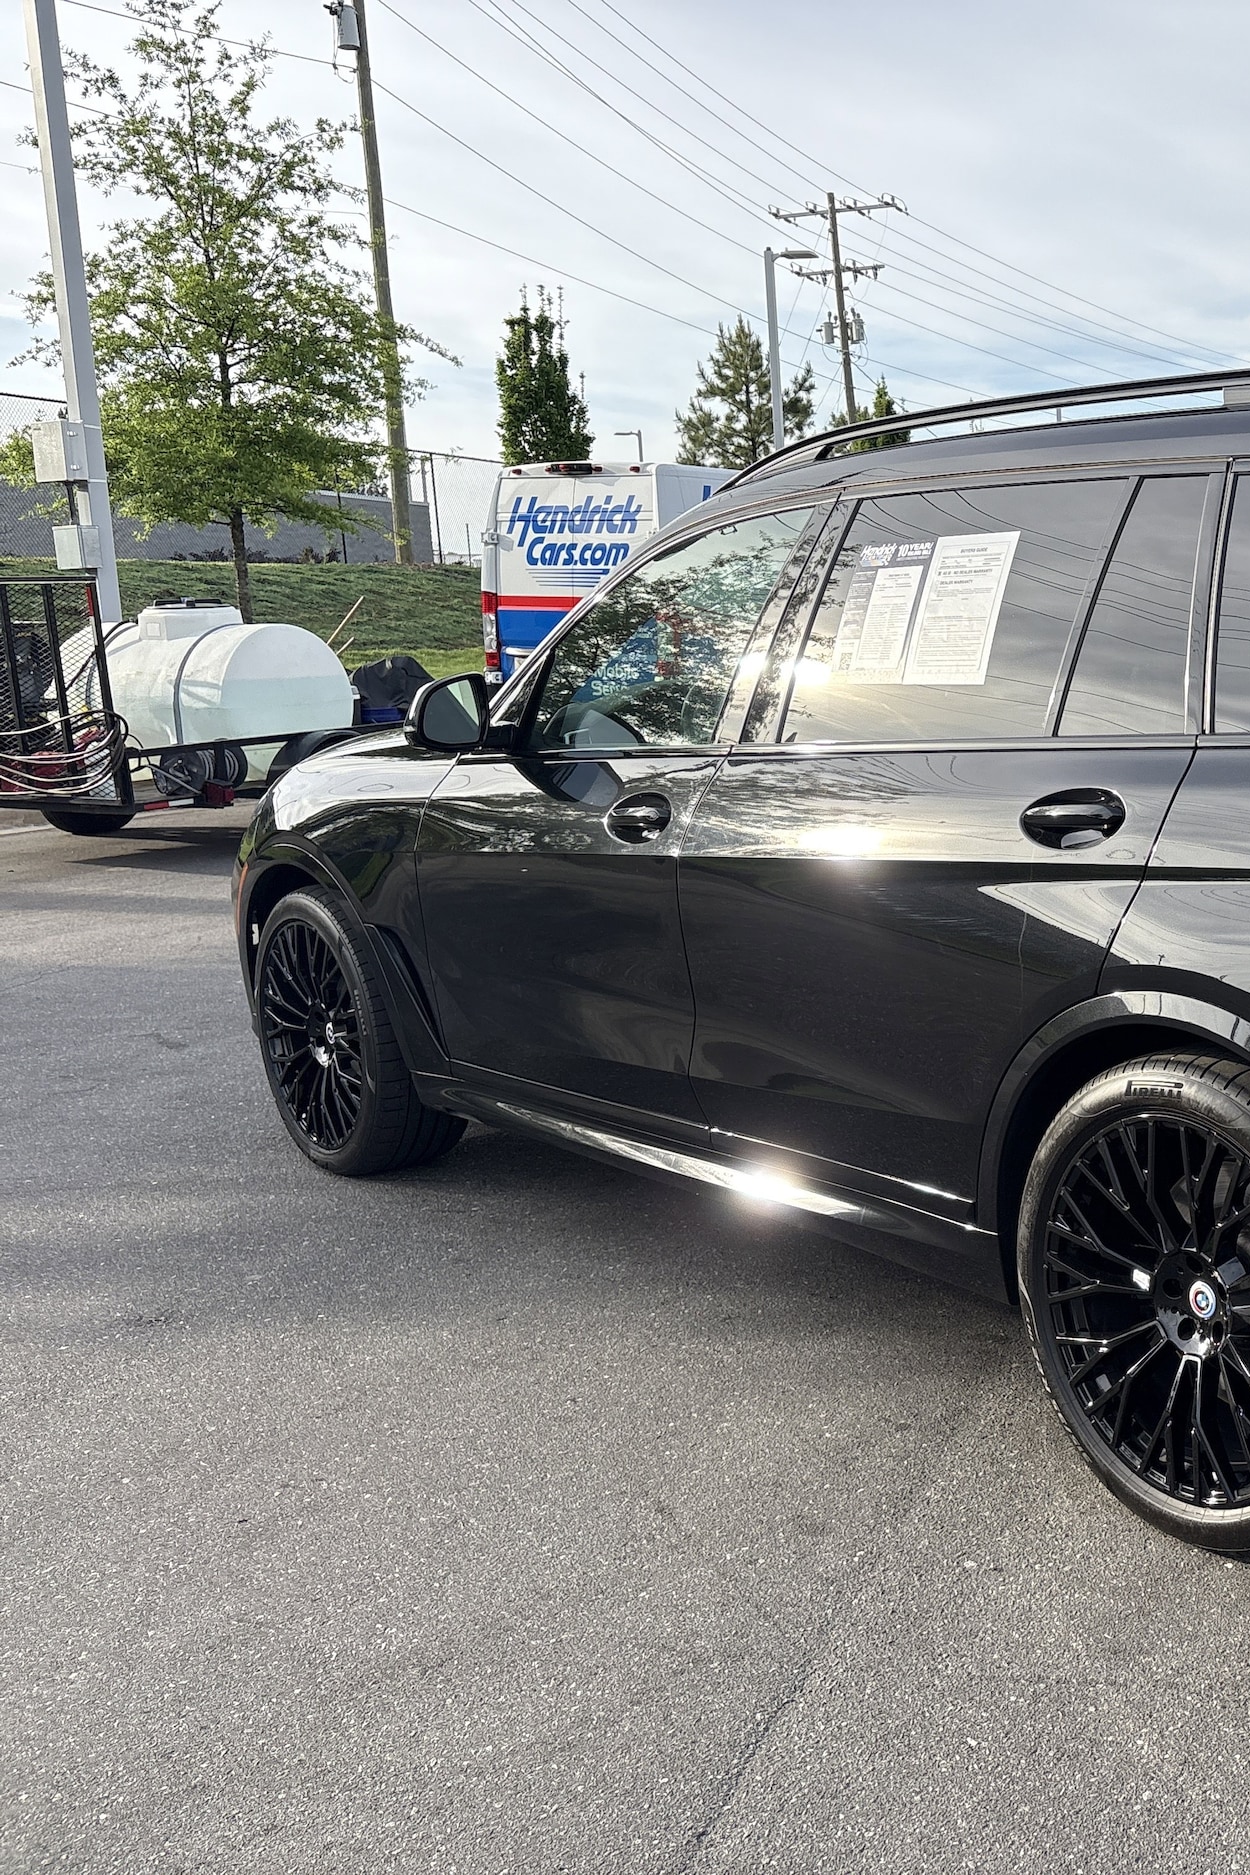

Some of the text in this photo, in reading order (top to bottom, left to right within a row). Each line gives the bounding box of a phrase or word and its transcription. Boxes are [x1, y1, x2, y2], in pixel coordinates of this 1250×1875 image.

[507, 495, 643, 547] Hendrick
[526, 536, 630, 567] Cars.com
[898, 544, 909, 557] 10
[1125, 1080, 1184, 1098] PIRELLI
